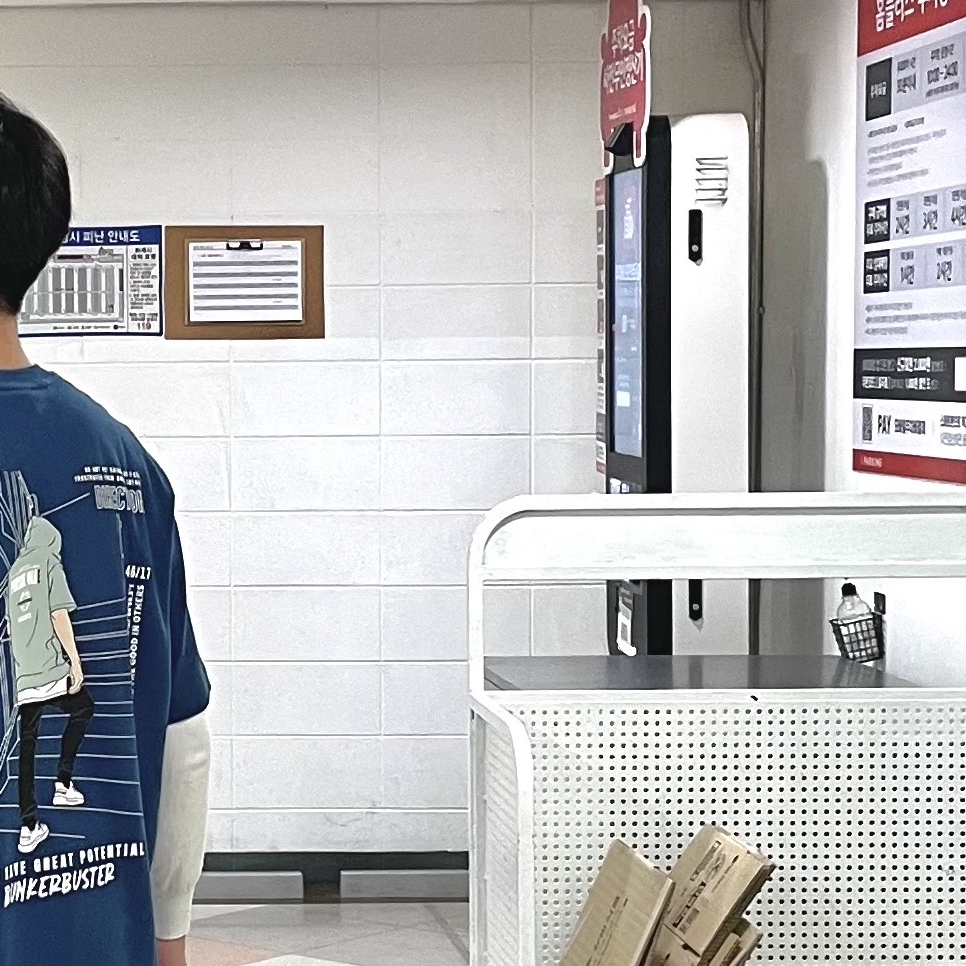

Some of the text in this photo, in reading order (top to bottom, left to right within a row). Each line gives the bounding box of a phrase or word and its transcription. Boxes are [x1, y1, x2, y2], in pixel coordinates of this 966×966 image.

[83, 231, 105, 244] 피난
[107, 229, 141, 243] 안내도
[132, 625, 140, 636] IN
[130, 637, 139, 666] GOOD
[33, 853, 74, 873] GREAT
[79, 842, 145, 865] POTENTIAL
